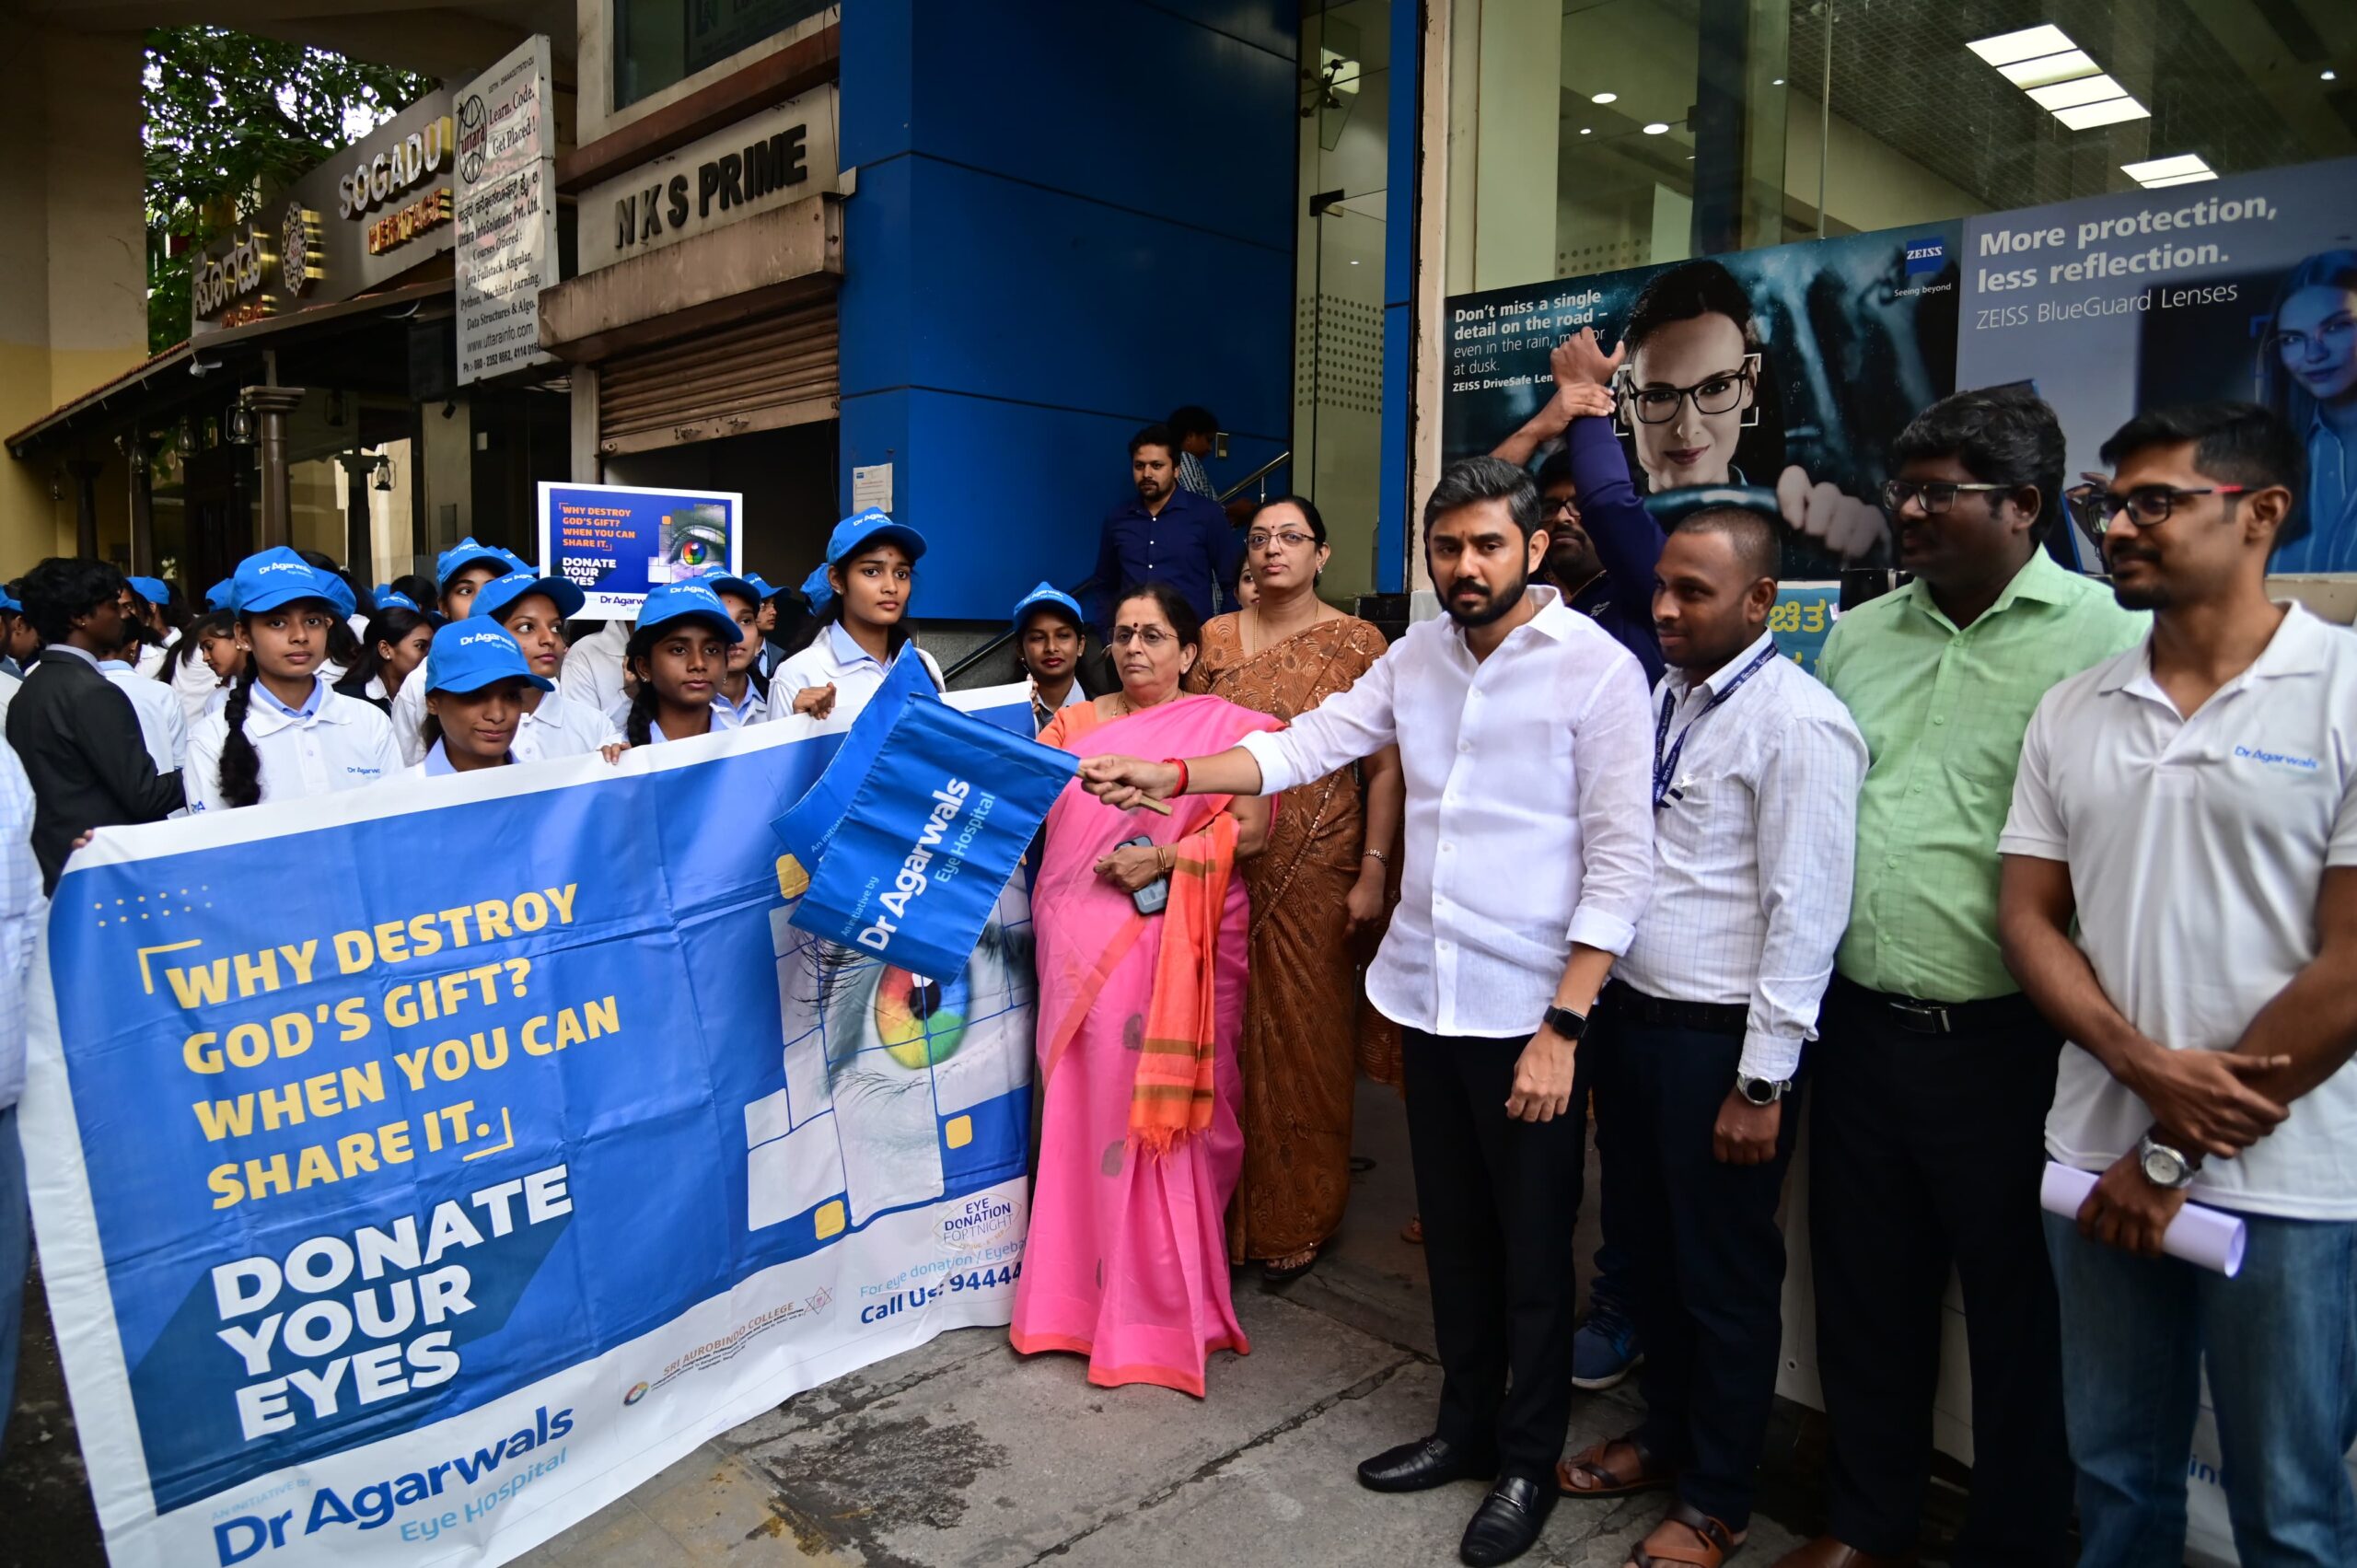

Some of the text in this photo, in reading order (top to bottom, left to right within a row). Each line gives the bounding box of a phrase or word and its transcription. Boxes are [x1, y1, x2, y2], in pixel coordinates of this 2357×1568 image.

[490, 84, 535, 125] Learn. Code.
[493, 134, 505, 156] Get
[507, 119, 531, 147] Placed
[339, 117, 451, 220] SOGADU
[699, 123, 807, 217] PRIME
[369, 188, 453, 254] HERITAGE
[459, 195, 540, 248] Uttara InfoSolutions Pvt. Ltd.
[1980, 197, 2278, 257] More protection,
[473, 243, 495, 261] Courses
[496, 228, 519, 251] Offered
[1907, 246, 1943, 260] ZEISS
[466, 274, 476, 290] Java
[505, 250, 533, 272] Angular,
[1978, 242, 2229, 293] less reflection.
[483, 285, 508, 303] Machine
[509, 273, 541, 293] Learning,
[1894, 283, 1951, 296] Seeing beyond
[467, 297, 536, 331] Data Structures & Algo.
[1455, 289, 1602, 323] Don't miss a single
[1976, 284, 2238, 330] ZEISS BlueGuard Lenses
[467, 322, 534, 354] www.uttarainfo.com
[1454, 321, 1496, 340] detail
[1502, 322, 1519, 334] on
[1525, 316, 1550, 331] the
[1556, 308, 1594, 327] road
[486, 354, 498, 367] 2352
[1454, 343, 1481, 358] even
[1486, 342, 1497, 354] in
[1502, 337, 1522, 352] the
[1527, 334, 1553, 350] rain,
[1453, 358, 1500, 376] at dusk.
[1453, 373, 1553, 392] ZEISS DriveSafe Len
[563, 506, 632, 517] WHY DESTROY
[563, 517, 621, 527] GOD'S GIFT?
[563, 528, 593, 537] WHEN
[563, 538, 609, 548] SHARE IT.
[259, 565, 271, 575] Dr
[563, 557, 617, 568] DONATE
[563, 567, 599, 576] YOUR
[600, 596, 612, 604] Dr
[613, 596, 644, 607] Agarw
[460, 637, 474, 645] Dr
[2235, 746, 2250, 756] Dr
[811, 842, 823, 853] An
[934, 792, 996, 883] Eye Hospital
[856, 777, 970, 951] Dr Agarwals
[841, 877, 880, 937] An initiative by
[166, 883, 578, 1010] WHY DESTROY
[183, 958, 531, 1074] GOD'S GIFT?
[192, 994, 621, 1143] WHEN YOU CAN
[207, 1099, 491, 1210] SHARE IT.
[945, 1202, 1012, 1231] DONATION
[966, 1197, 990, 1214] EYE
[212, 1164, 574, 1320] DONATE
[944, 1214, 1014, 1243] FORTNIGHT
[860, 1284, 883, 1297] For
[886, 1272, 907, 1289] eye
[910, 1253, 972, 1278] donation
[985, 1237, 1028, 1260] Eyeba
[217, 1265, 477, 1376] YOUR
[861, 1294, 903, 1324] Call
[663, 1360, 680, 1376] SRI
[682, 1326, 746, 1364] AUROBINDO
[748, 1301, 795, 1330] COLLEGE
[236, 1330, 460, 1442] EYES
[214, 1405, 575, 1568] Dr Agarwals
[231, 1481, 295, 1514] INITIATIVE
[400, 1446, 567, 1543] Eye Hospital
